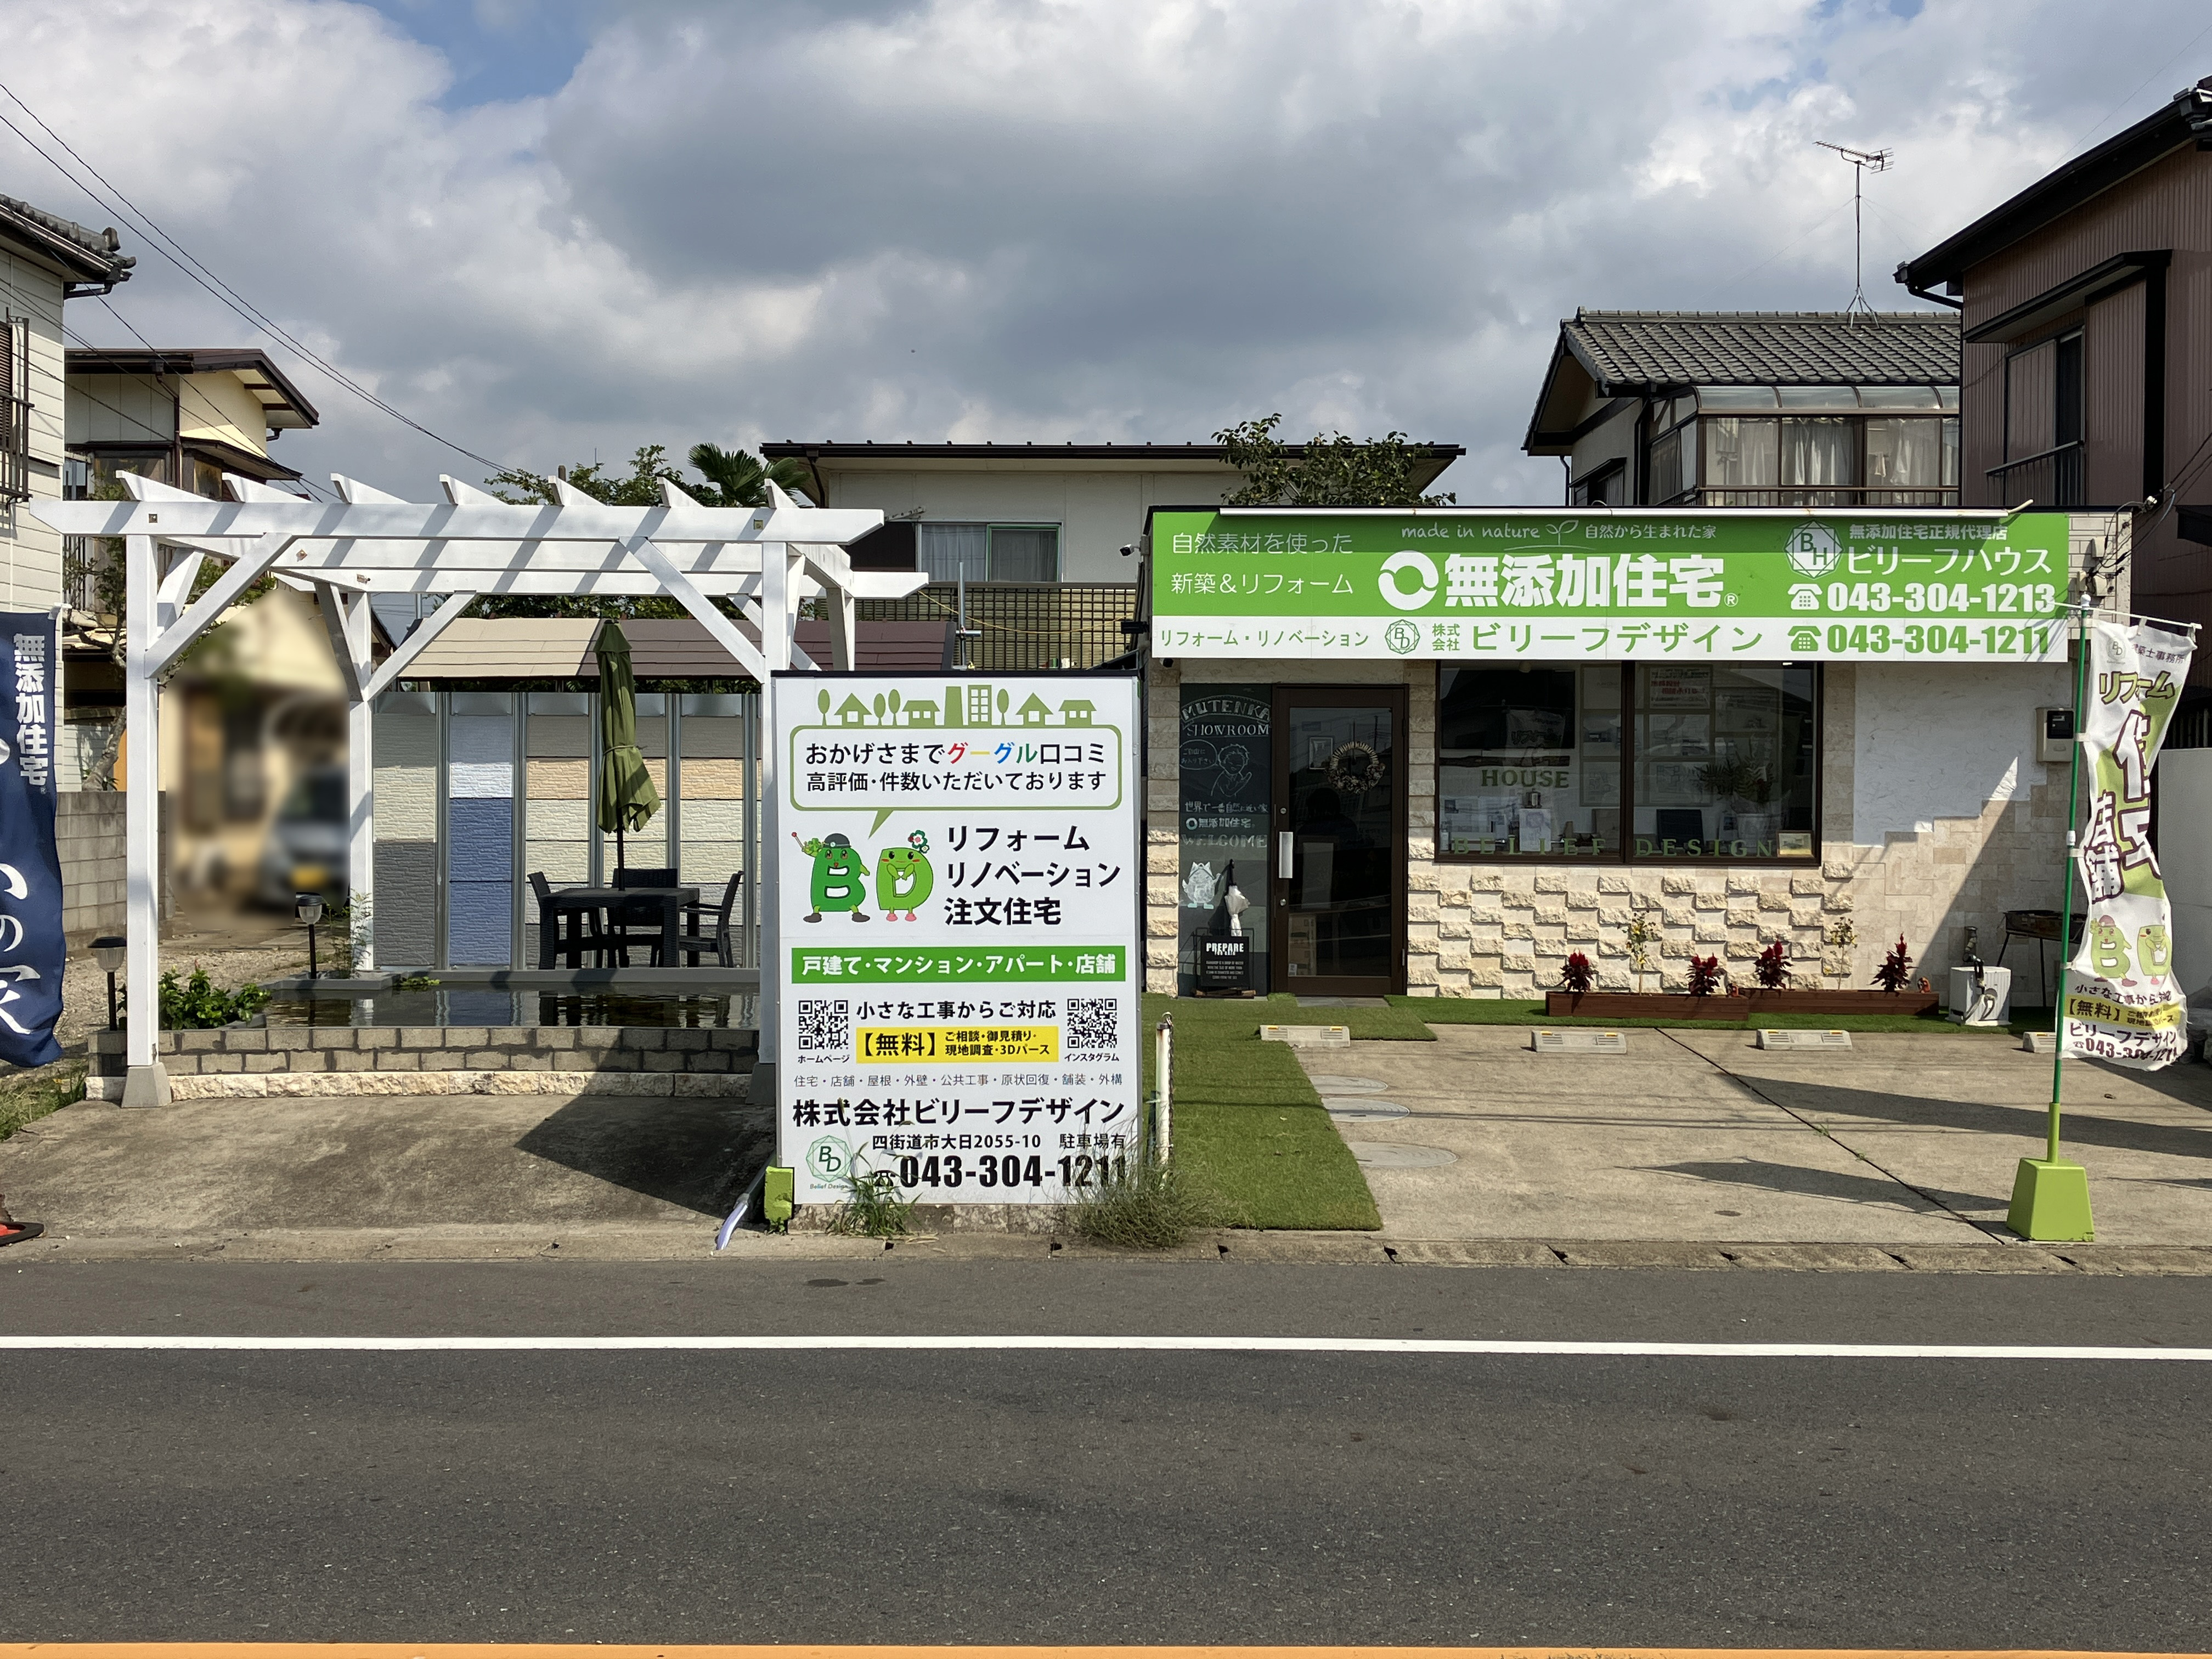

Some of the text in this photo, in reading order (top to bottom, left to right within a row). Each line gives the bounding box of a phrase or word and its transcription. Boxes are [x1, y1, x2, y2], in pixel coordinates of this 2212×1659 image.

[1402, 523, 1541, 539] made in nature
[1585, 524, 1717, 539] 自然から生まれた家
[1849, 524, 2008, 540] 無添加住宅正規代理店
[1172, 532, 1354, 555] 自然素材を使った
[1848, 545, 2052, 576] ビリーフハウス
[1827, 582, 2056, 613] 043-304-1213
[1160, 629, 1369, 647] リフォーム・リノベーション
[1432, 623, 1460, 637] 株式
[1472, 622, 1763, 653] ビリーフデザイン
[1827, 625, 2049, 654] 043-304-1211
[1432, 638, 1460, 651] 会社
[1181, 699, 1271, 720] MUTENKA
[1187, 724, 1269, 737] SHOWROOM
[805, 741, 1105, 766] おかげさまでグーグル口コミ
[806, 771, 1107, 792] 高評価・件数いただいております
[1481, 768, 1569, 788] HOUSE
[947, 824, 1090, 853] リフォーム
[1180, 833, 1268, 848] WELCOME
[1453, 834, 1606, 856] BELIEF
[1636, 839, 1777, 858] DESIGN
[947, 861, 1121, 889] リノベーション
[943, 896, 1062, 926] 注文住宅
[1205, 943, 1244, 952] PREPARE
[802, 953, 1116, 975] 戸建て・マンション・アパート・店舗
[856, 1001, 1057, 1020] 小さな工事からご対応
[865, 1032, 936, 1057] 【無料】
[945, 1043, 1051, 1056] 現地調査・3Dパース
[797, 1053, 850, 1064] ホームページ
[1064, 1053, 1120, 1063] インスタグラム
[792, 1097, 1125, 1128] 株式会社ビリーフデザイン
[872, 1133, 1126, 1151] 四街道市大日2055-10 駐車場有
